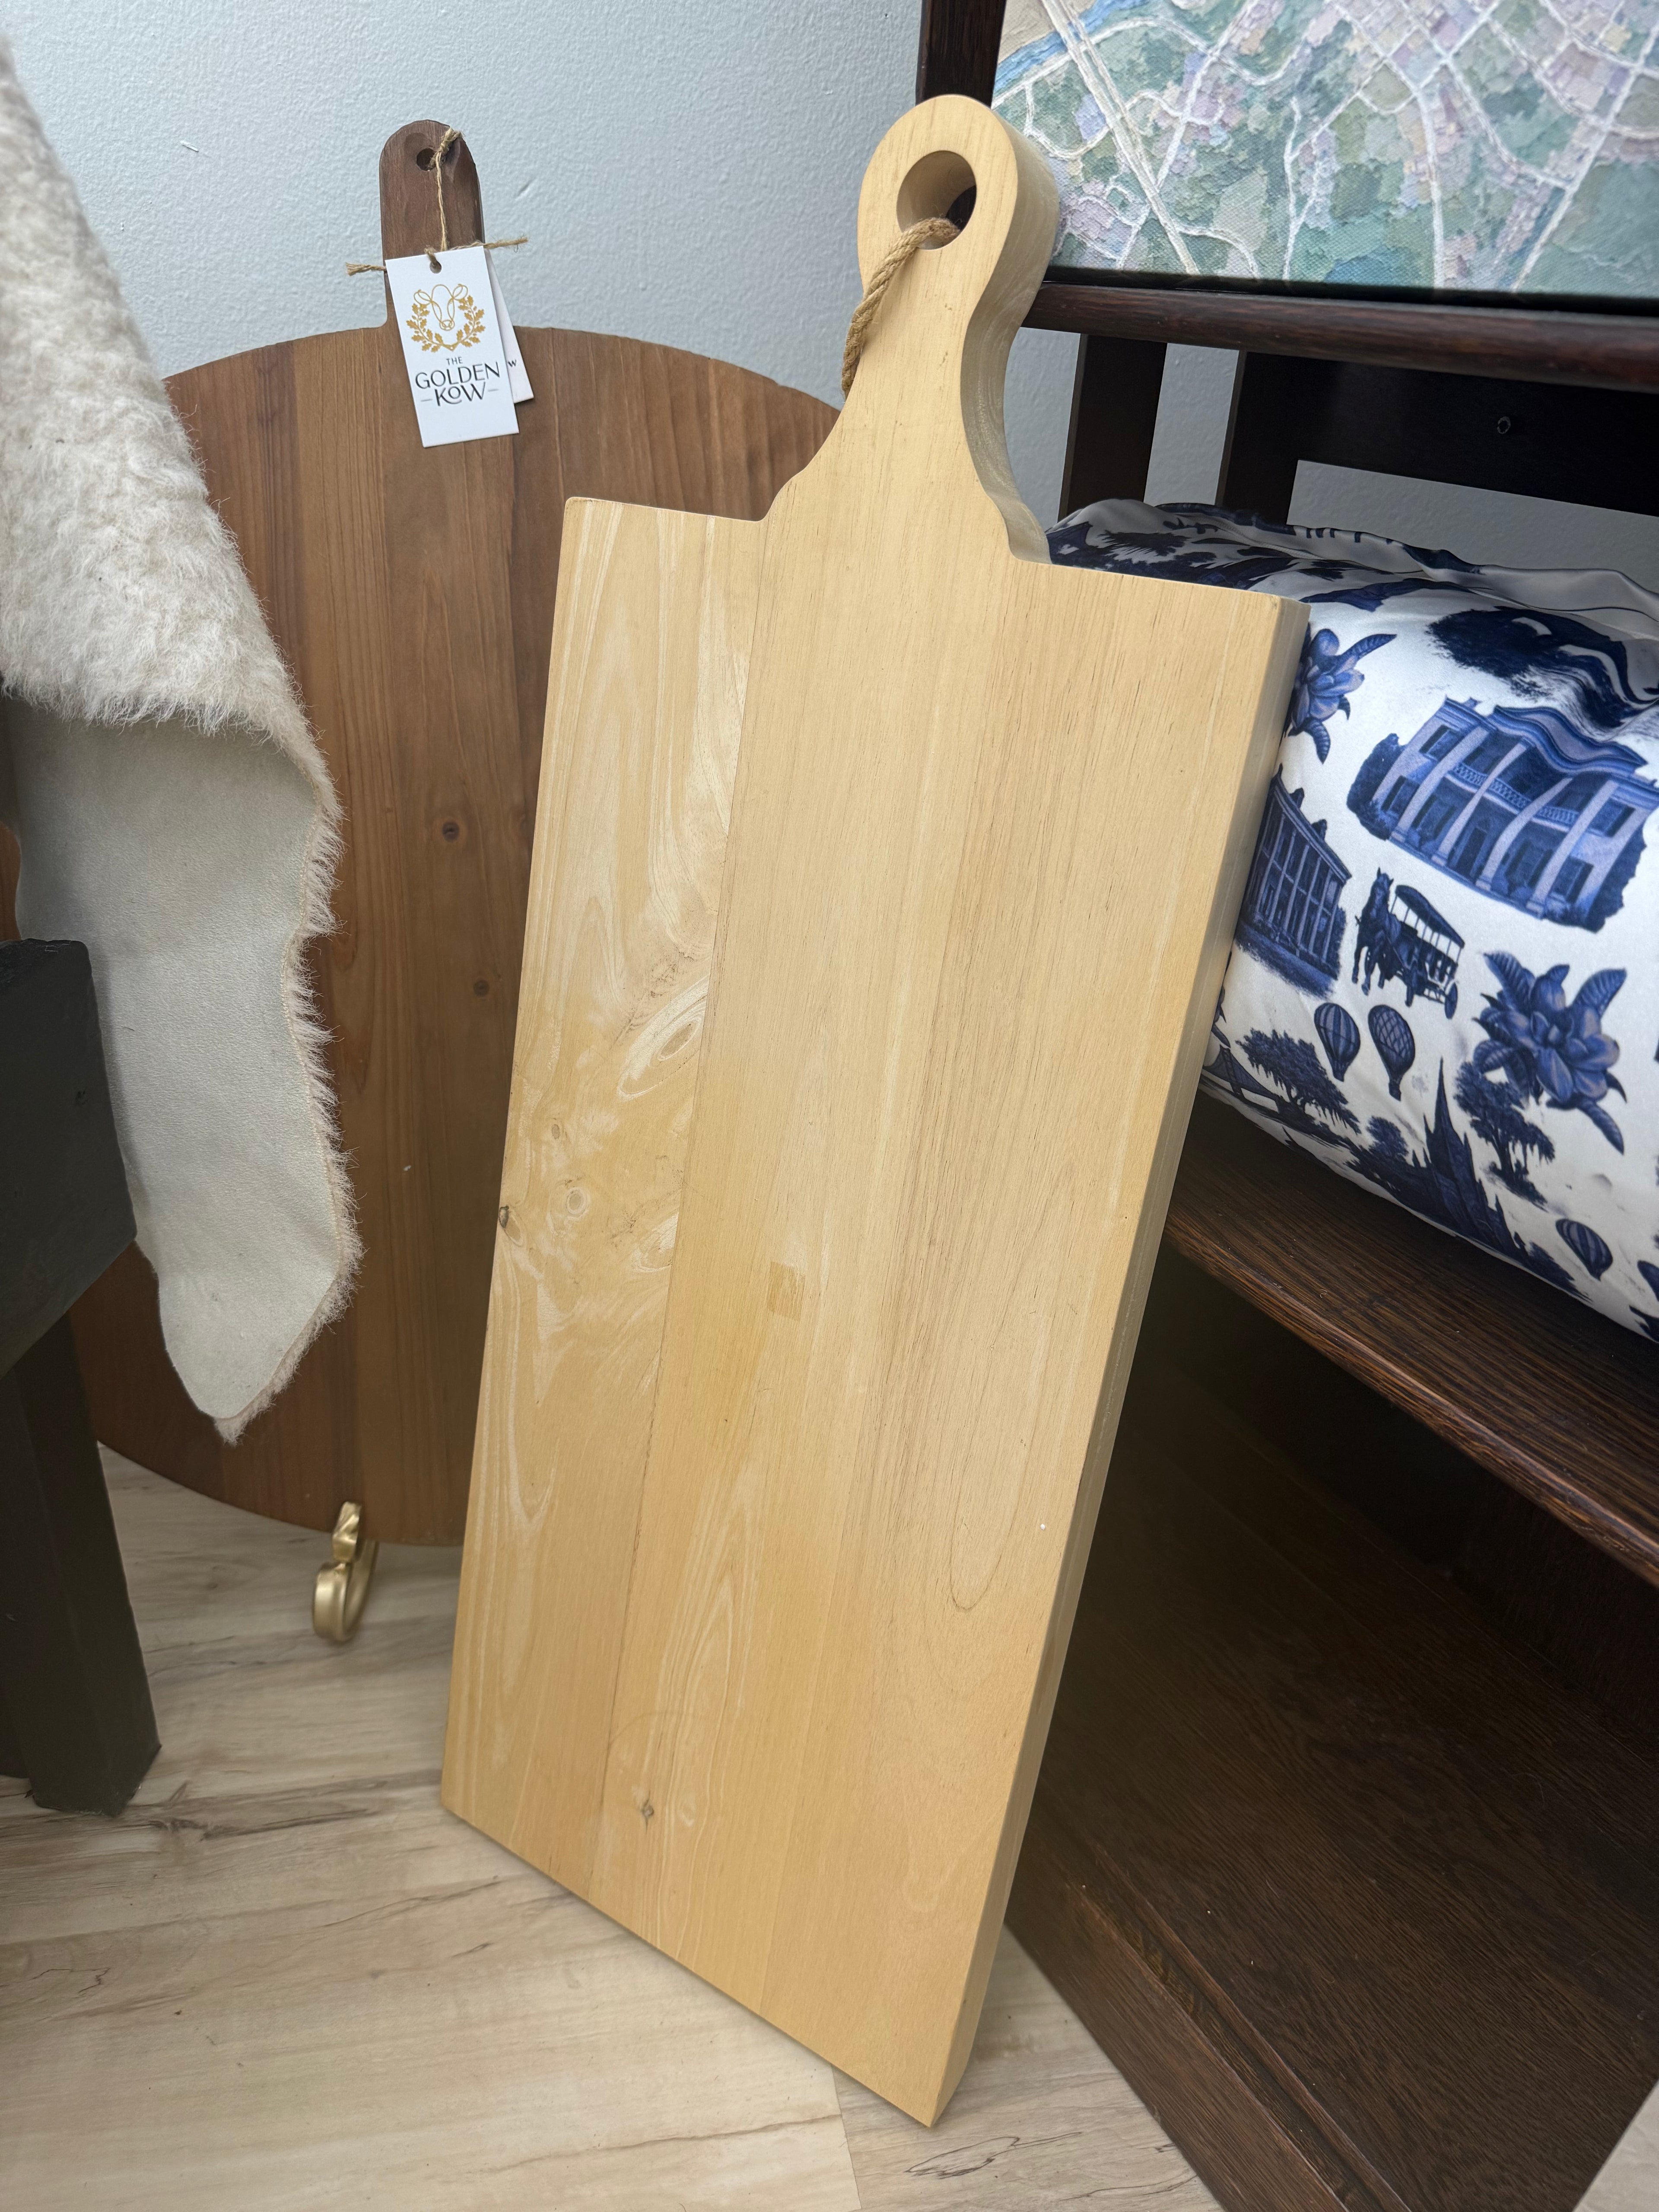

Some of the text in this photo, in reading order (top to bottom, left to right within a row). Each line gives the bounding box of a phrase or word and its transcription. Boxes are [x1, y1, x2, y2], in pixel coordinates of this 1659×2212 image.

[446, 356, 463, 365] THE
[415, 361, 500, 389] GOLDEN
[435, 381, 486, 407] KOW
